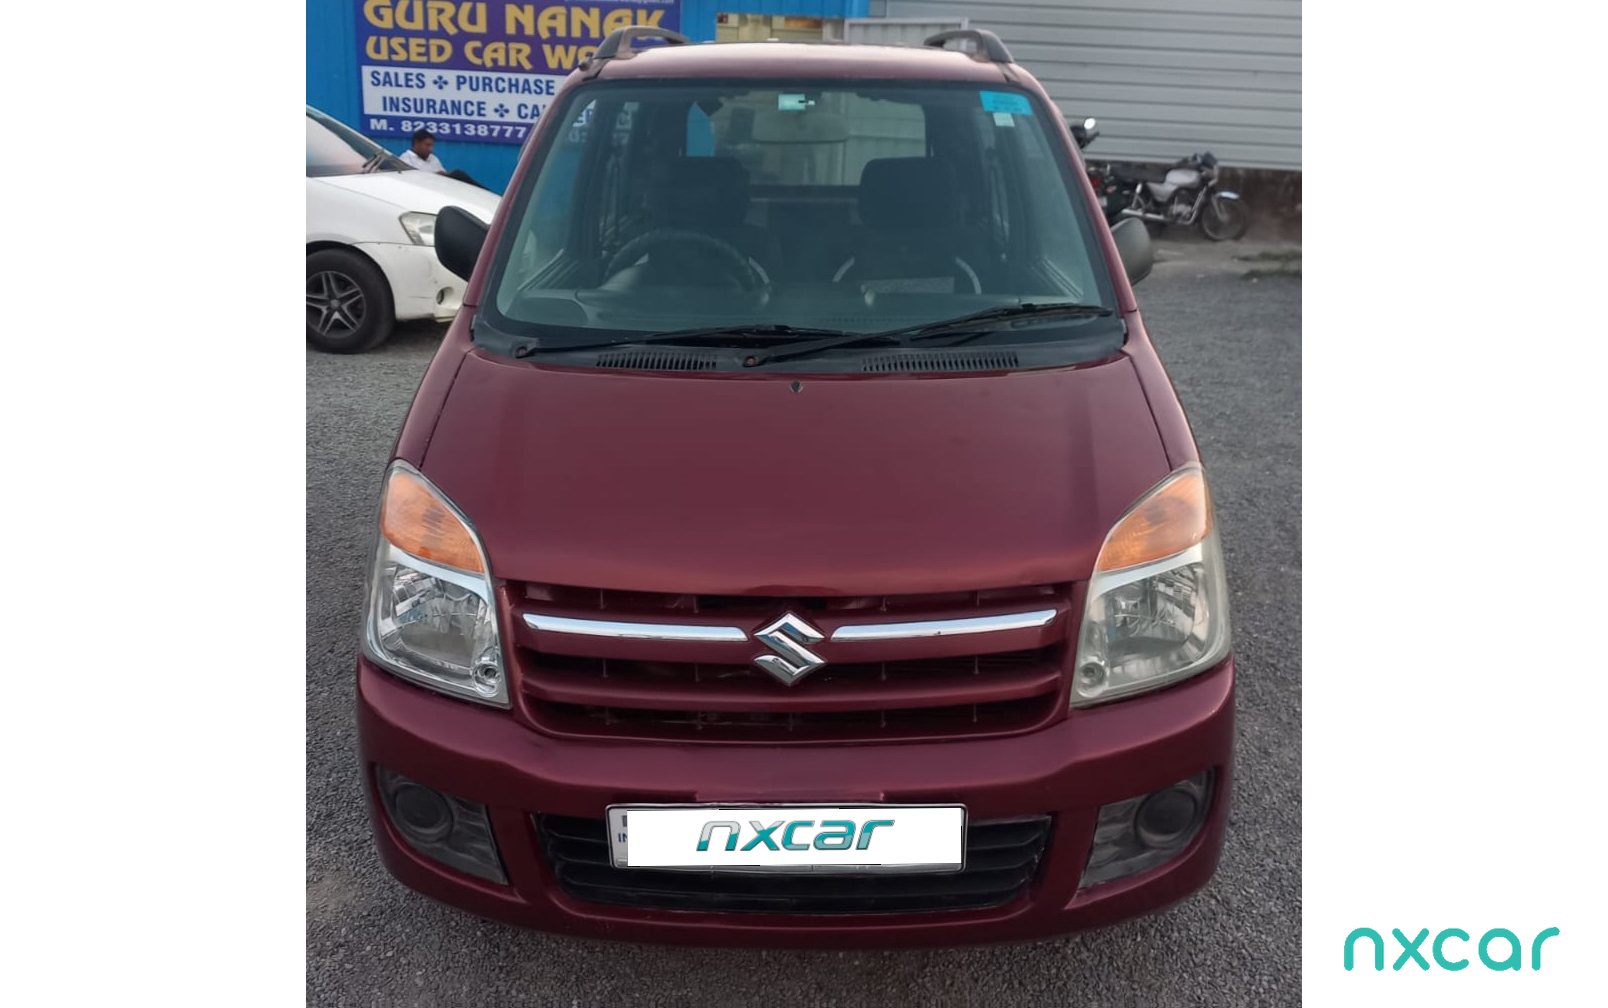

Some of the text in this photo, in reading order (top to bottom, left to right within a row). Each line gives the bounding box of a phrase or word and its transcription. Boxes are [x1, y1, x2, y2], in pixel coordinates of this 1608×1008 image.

[363, 0, 666, 40] GURU NANAK
[365, 36, 453, 63] USED
[464, 40, 532, 70] CAR
[370, 70, 556, 96] SALES PURCHASE
[382, 96, 547, 120] INSURANCE CA
[370, 118, 527, 138] M. 8233138777
